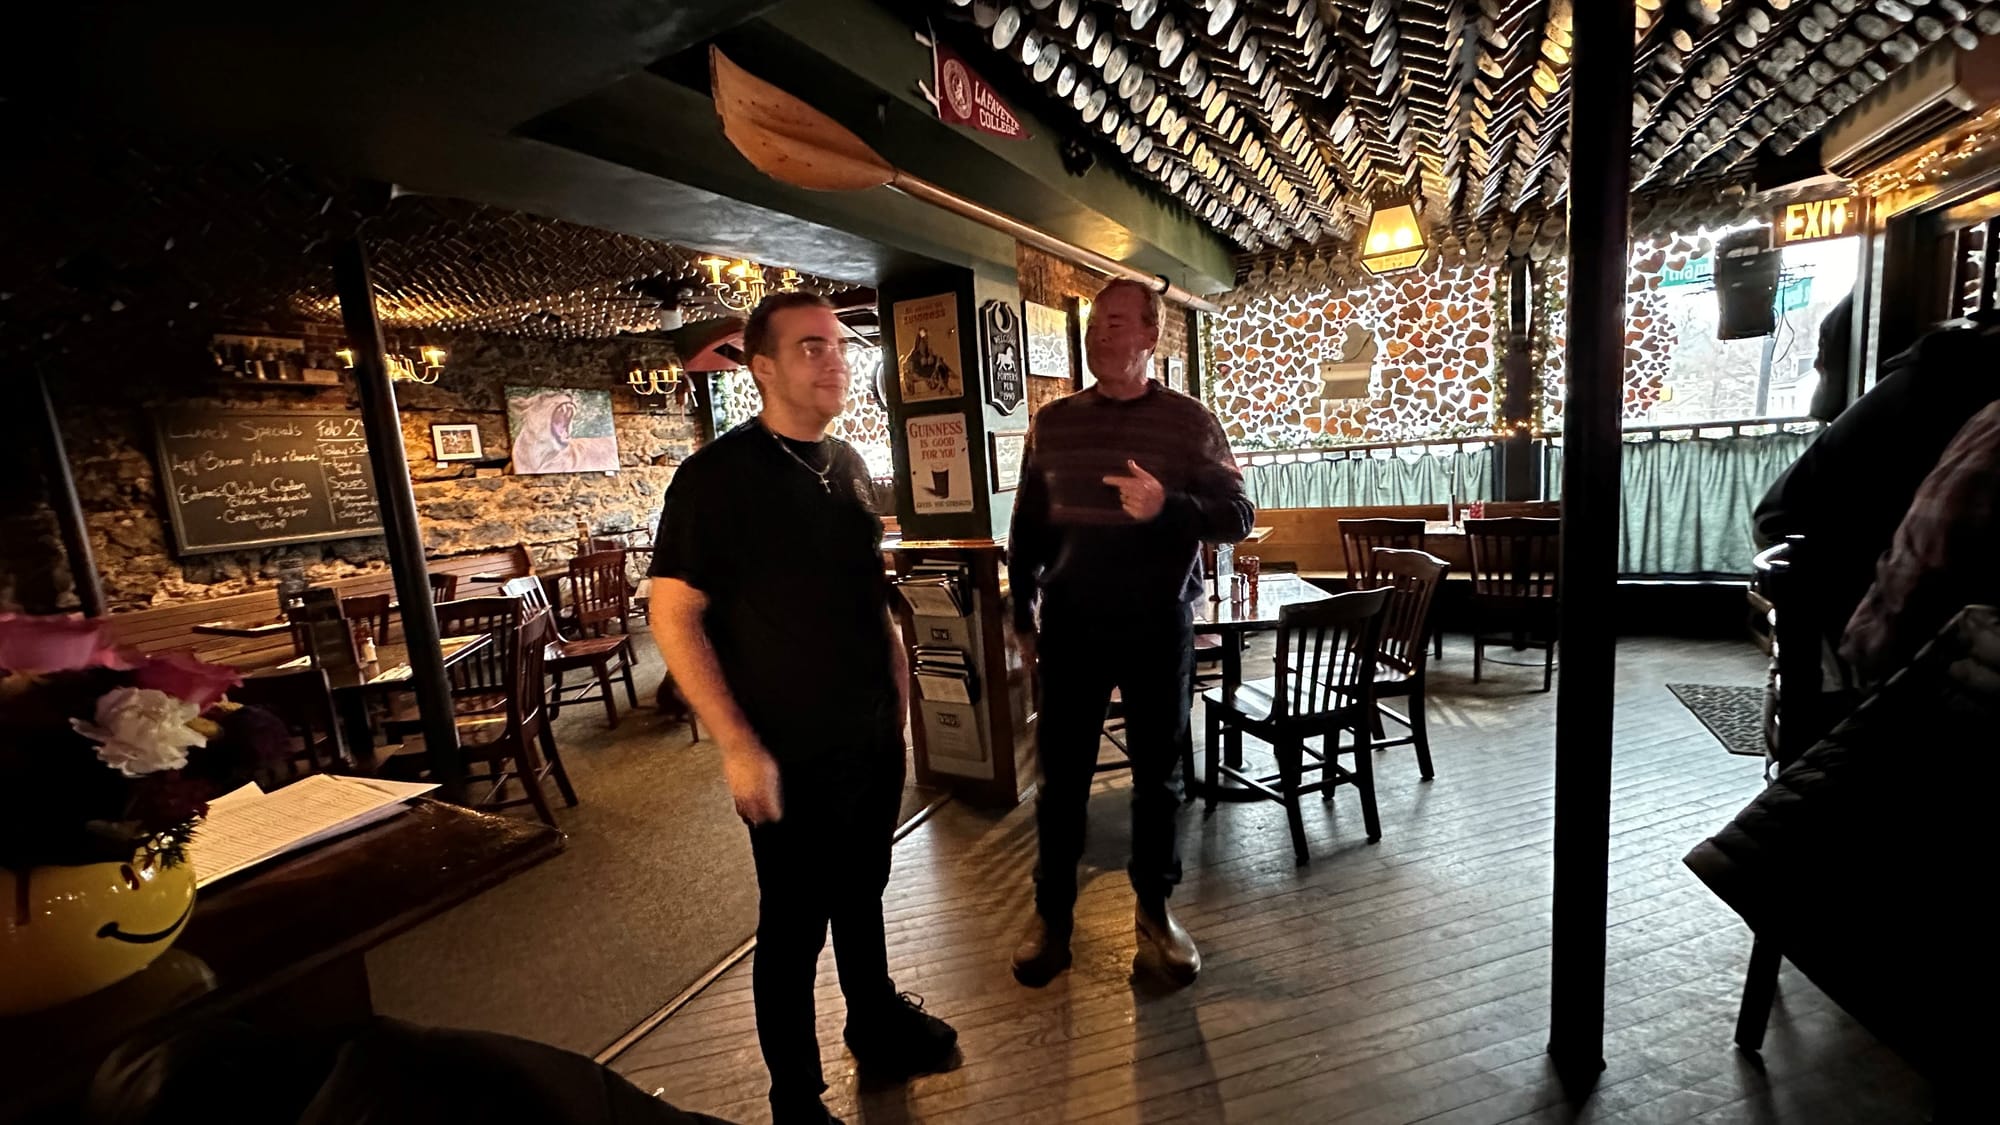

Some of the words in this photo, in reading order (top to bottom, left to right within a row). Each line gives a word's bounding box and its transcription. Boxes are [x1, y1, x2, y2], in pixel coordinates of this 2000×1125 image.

[975, 81, 1020, 130] LAFAYETTE
[979, 108, 1017, 136] COLLEGE
[1785, 197, 1850, 241] EXIT
[1003, 382, 1015, 392] PUB
[909, 421, 964, 439] GUINNESS
[920, 439, 930, 449] IS
[932, 437, 956, 447] GOOD
[921, 450, 938, 460] FOR
[939, 448, 957, 459] YOU
